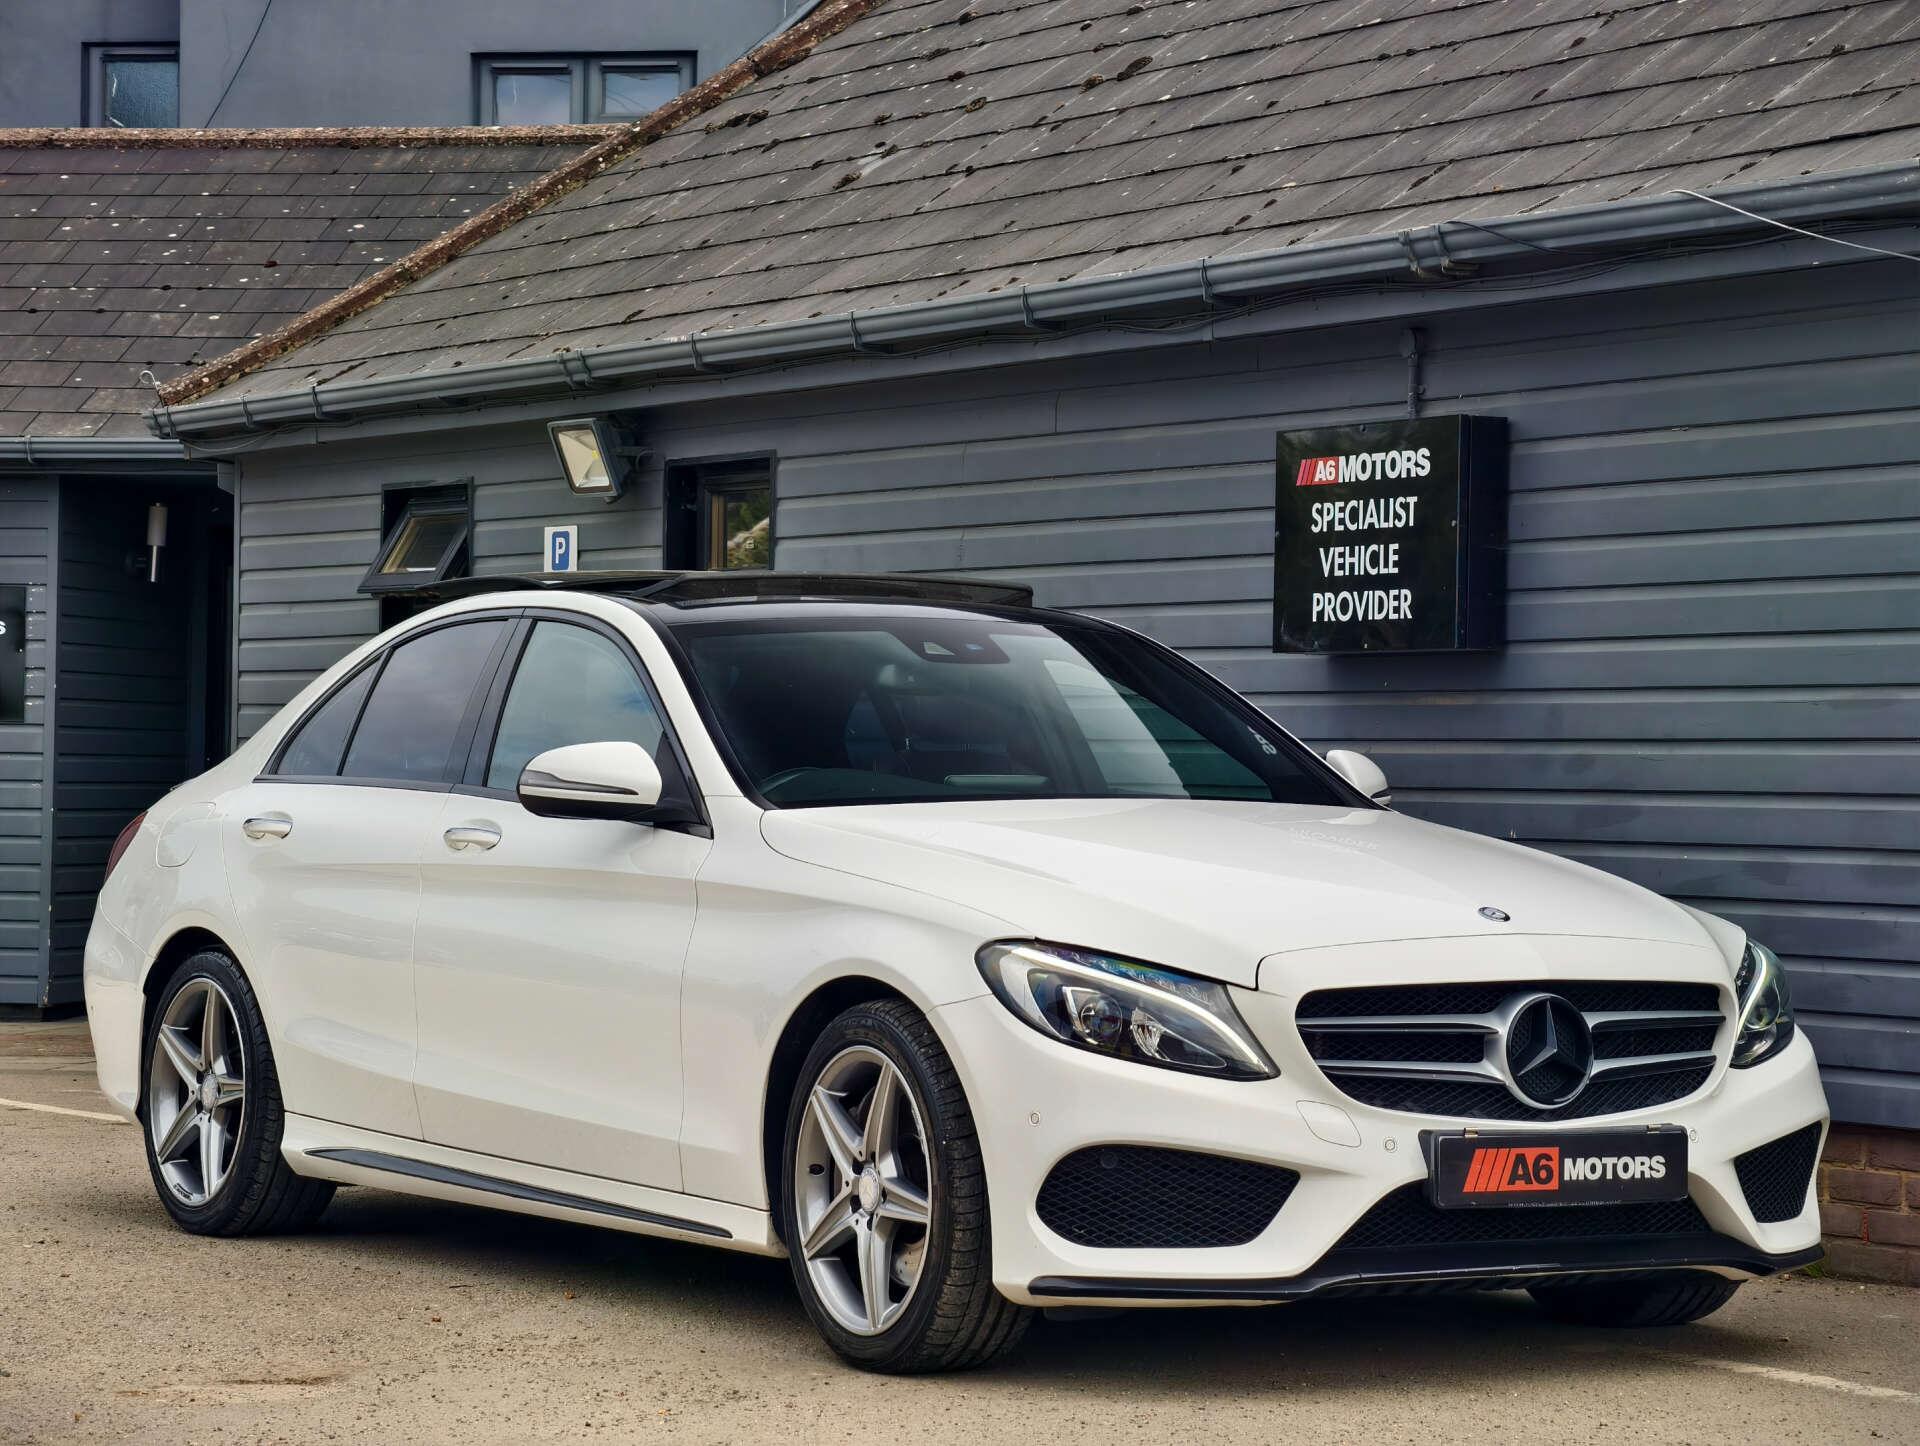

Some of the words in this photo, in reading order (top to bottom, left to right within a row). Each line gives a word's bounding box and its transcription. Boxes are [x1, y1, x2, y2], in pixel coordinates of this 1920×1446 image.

[1338, 448, 1431, 483] MOTORS
[1310, 496, 1418, 534] SPECIALIST
[555, 537, 566, 564] P
[1319, 543, 1399, 578] VEHICLE
[1312, 589, 1412, 623] PROVIDER
[1507, 1153, 1554, 1186] A6
[1563, 1156, 1666, 1181] MOTORS
